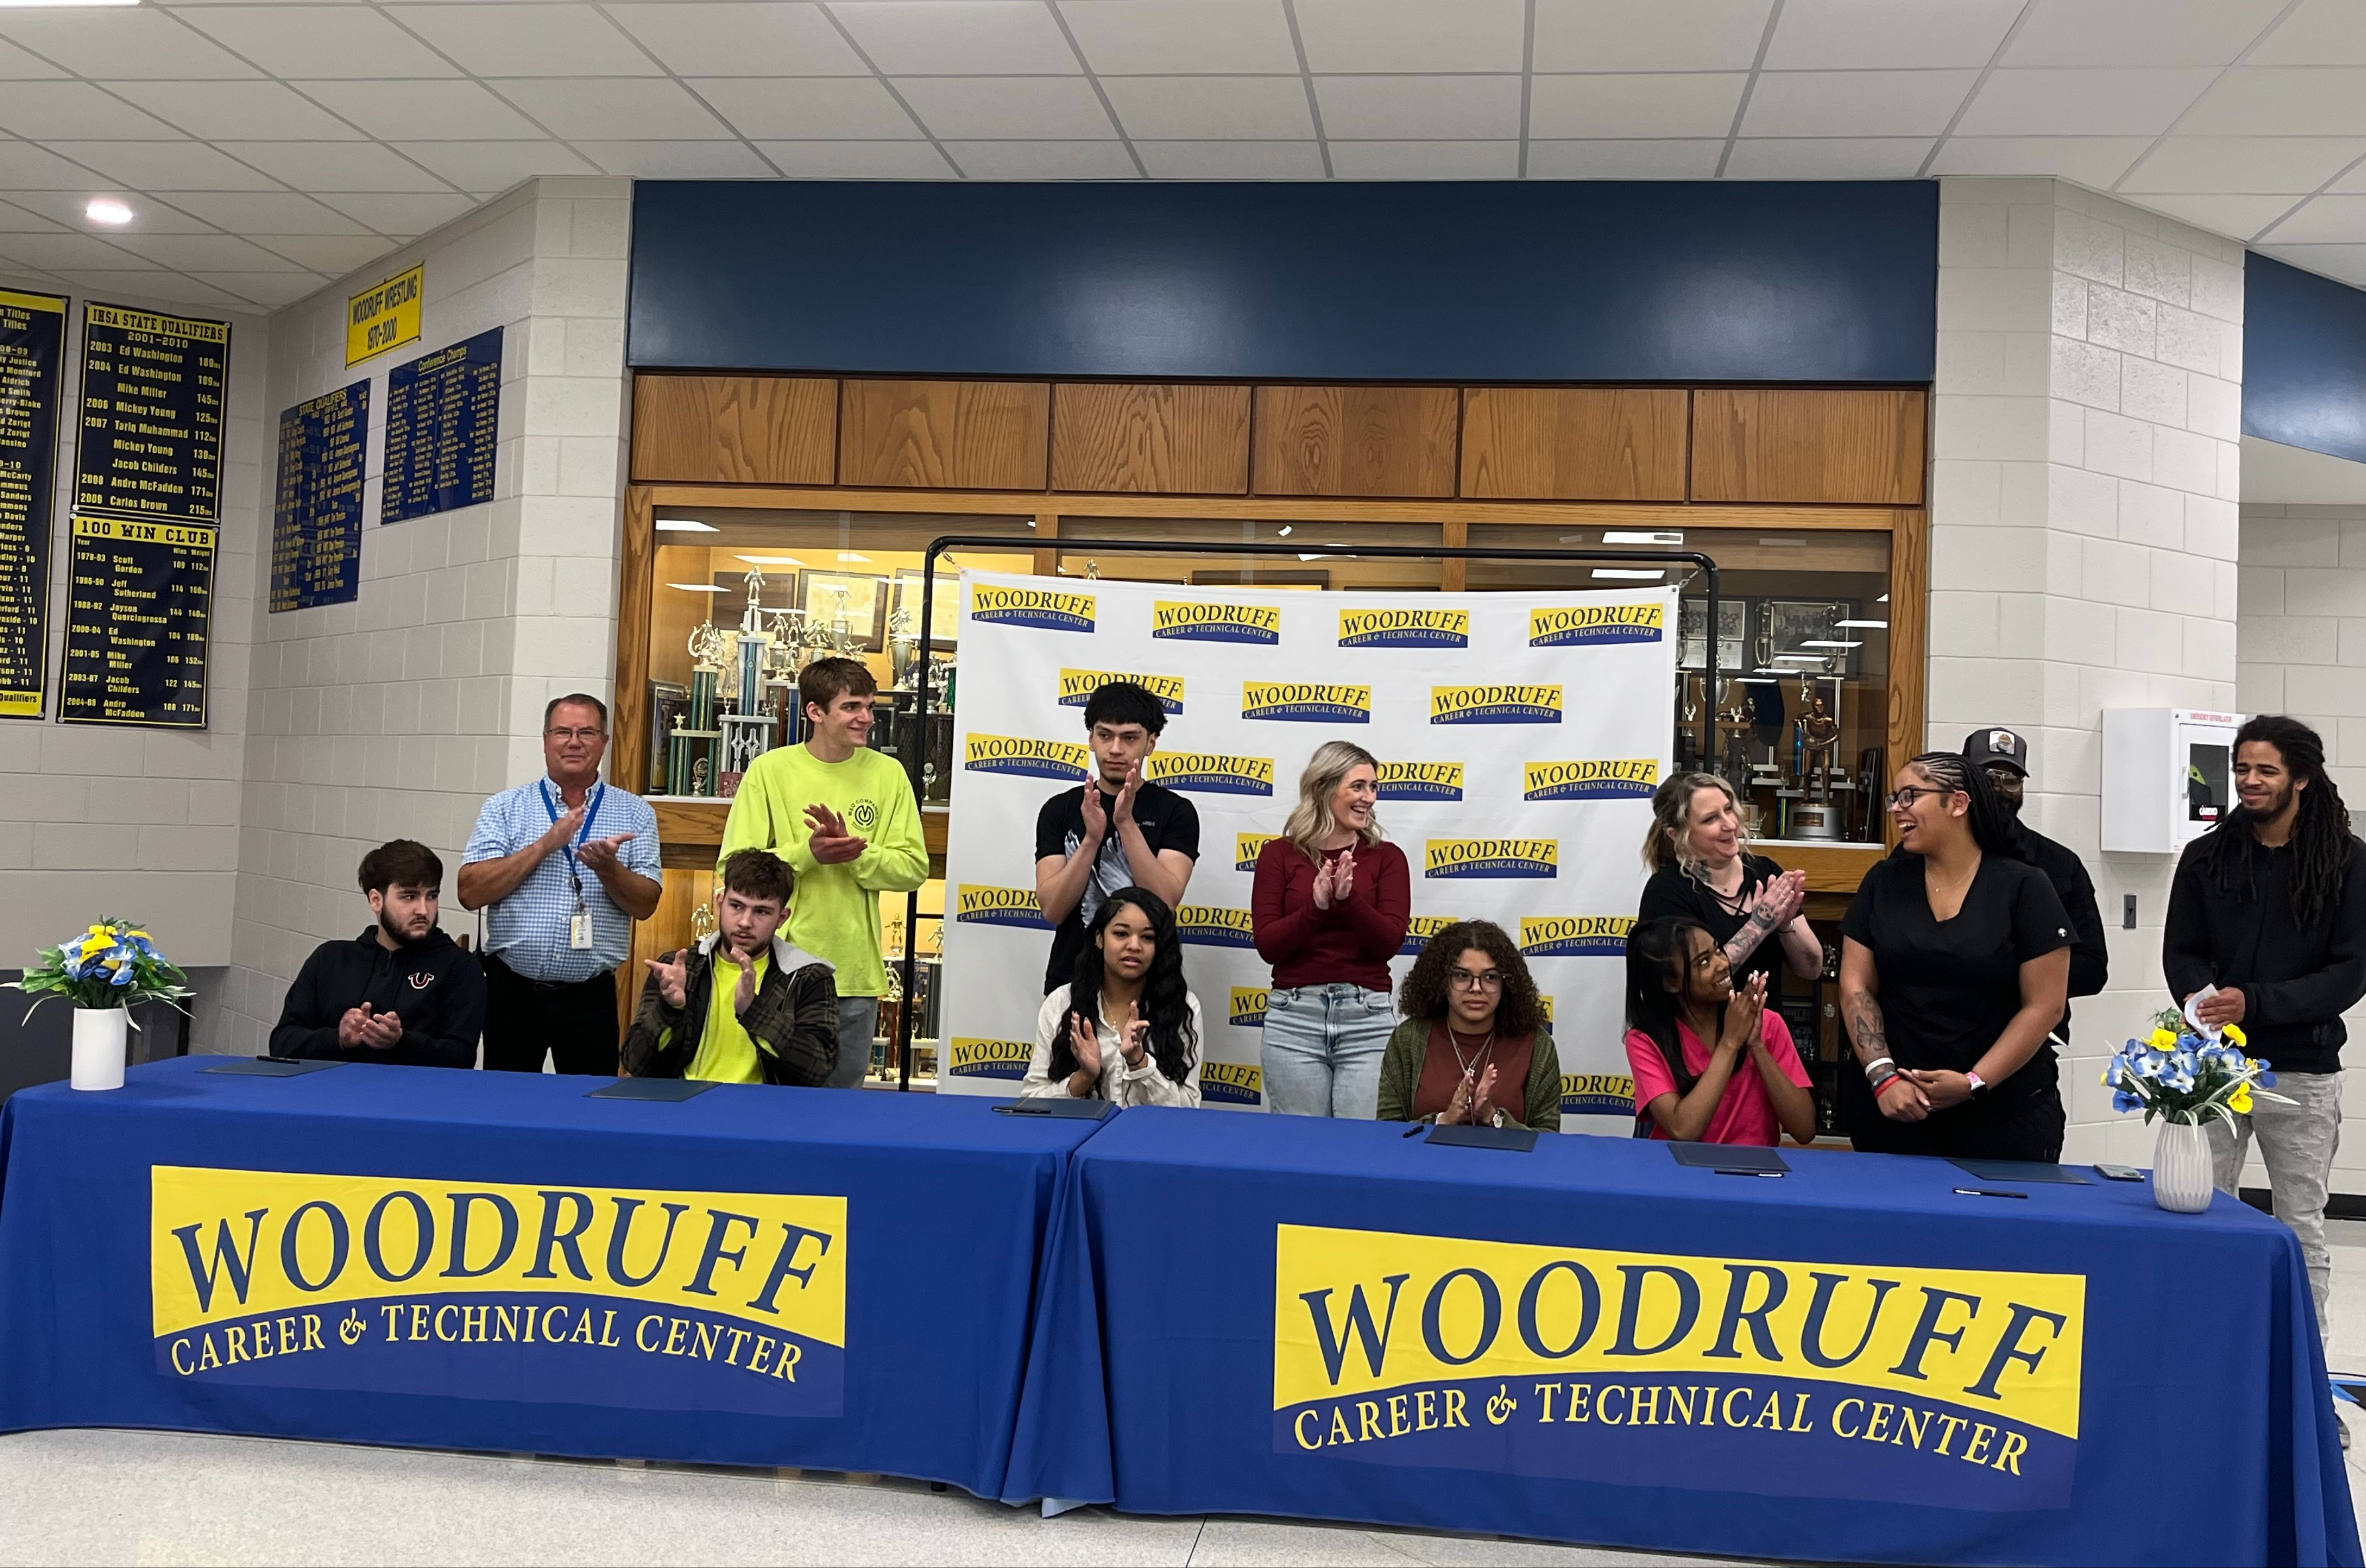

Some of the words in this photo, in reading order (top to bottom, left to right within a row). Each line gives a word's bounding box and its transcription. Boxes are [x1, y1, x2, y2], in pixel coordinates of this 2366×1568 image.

[385, 274, 417, 312] WRESTLING
[93, 309, 119, 325] IHSA
[123, 314, 157, 330] STATE
[162, 320, 223, 340] QUALIFIERS
[128, 332, 188, 348] 2001-2010
[90, 341, 112, 353] 2003
[119, 345, 130, 355] Ed
[133, 347, 183, 363] Washington
[88, 359, 111, 372] 2004
[118, 364, 129, 375] Ed
[132, 365, 181, 382] Washington
[8, 387, 31, 397] Smith
[117, 383, 139, 394] Mike
[141, 386, 166, 398] Miller
[86, 397, 108, 409] 2006
[116, 401, 147, 416] Mickey
[150, 405, 176, 420] Young
[85, 416, 107, 428] 2007
[115, 420, 137, 433] Tariq
[139, 423, 188, 438] Muhammad
[113, 439, 145, 453] Mickey
[147, 443, 173, 456] Young
[112, 458, 139, 470] Jacob
[142, 461, 177, 475] Childers
[111, 477, 137, 489] Andre
[139, 479, 183, 494] McFadden
[110, 495, 138, 509] Carlos
[141, 499, 168, 511] Brown
[5, 512, 25, 521] Davis
[82, 520, 111, 535] 100
[121, 524, 156, 540] WIN
[166, 528, 209, 544] CLUB
[111, 579, 127, 588] Jeff
[114, 588, 156, 599] Sutherland
[976, 590, 1093, 615] WOODRUFF
[975, 610, 1003, 620] CAREER
[1013, 610, 1056, 620] TECHNICAL
[1058, 614, 1089, 627] CENTER
[1157, 605, 1277, 628] WOODRUFF
[1343, 610, 1466, 635] WOODRUFF
[1534, 606, 1660, 634] WOODRUFF
[1155, 625, 1185, 638] CAREER
[1241, 626, 1272, 639] CENTER
[1341, 634, 1371, 646] CAREER
[1383, 631, 1427, 639] TECHNICAL
[1430, 631, 1462, 642] CENTER
[1532, 632, 1564, 647] CAREER
[1575, 627, 1620, 637] TECHNICAL
[1623, 626, 1655, 637] CENTER
[110, 636, 156, 647] Washington
[107, 651, 126, 660] Mike
[109, 660, 133, 670] Miller
[107, 684, 140, 694] Childers
[1247, 685, 1368, 707] WOODRUFF
[103, 699, 127, 708] Andre
[1062, 694, 1091, 705] CAREER
[1436, 686, 1560, 713] WOODRUFF
[105, 708, 145, 718] McFadden
[1245, 706, 1275, 718] CAREER
[1332, 706, 1363, 718] CENTER
[1433, 710, 1464, 724] CAREER
[1475, 706, 1521, 715] TECHNICAL
[1523, 706, 1555, 717] CENTER
[969, 739, 1087, 764] WOODRUFF
[967, 759, 997, 770] CAREER
[1007, 758, 1049, 769] TECHNICAL
[1051, 762, 1082, 776] CENTER
[1151, 755, 1271, 778] WOODRUFF
[1375, 762, 1461, 784] ODRUFF
[1528, 760, 1655, 788] WOODRUFF
[1190, 776, 1233, 784] TECHNICAL
[1235, 777, 1267, 791] CENTER
[1424, 784, 1456, 796] CENTER
[1527, 786, 1558, 800] CAREER
[1570, 782, 1615, 792] TECHNICAL
[1618, 781, 1650, 793] CENTER
[1430, 840, 1555, 866] WOODRUFF
[1428, 864, 1459, 877] CAREER
[1469, 861, 1516, 870] TECHNICAL
[1518, 861, 1550, 873] CENTER
[962, 889, 1037, 910] WOODR
[960, 910, 989, 922] CAREER
[999, 909, 1042, 919] TECHNICAL
[1182, 927, 1227, 937] TECHNICAL
[1525, 917, 1638, 944] WOODRUF
[1523, 943, 1554, 955] CAREER
[1565, 938, 1611, 947] TECHNICAL
[171, 1190, 832, 1315] WOODRUFF
[1299, 1260, 2066, 1401] WOODRUFF
[172, 1313, 325, 1376] CAREER
[340, 1309, 366, 1345] &
[381, 1303, 620, 1348] TECHNICAL
[636, 1315, 803, 1383] CENTER
[1294, 1390, 1469, 1451] CAREER
[1486, 1384, 1517, 1425] &
[1535, 1383, 1812, 1432] TECHNICAL
[1831, 1398, 2030, 1476] CENTER
